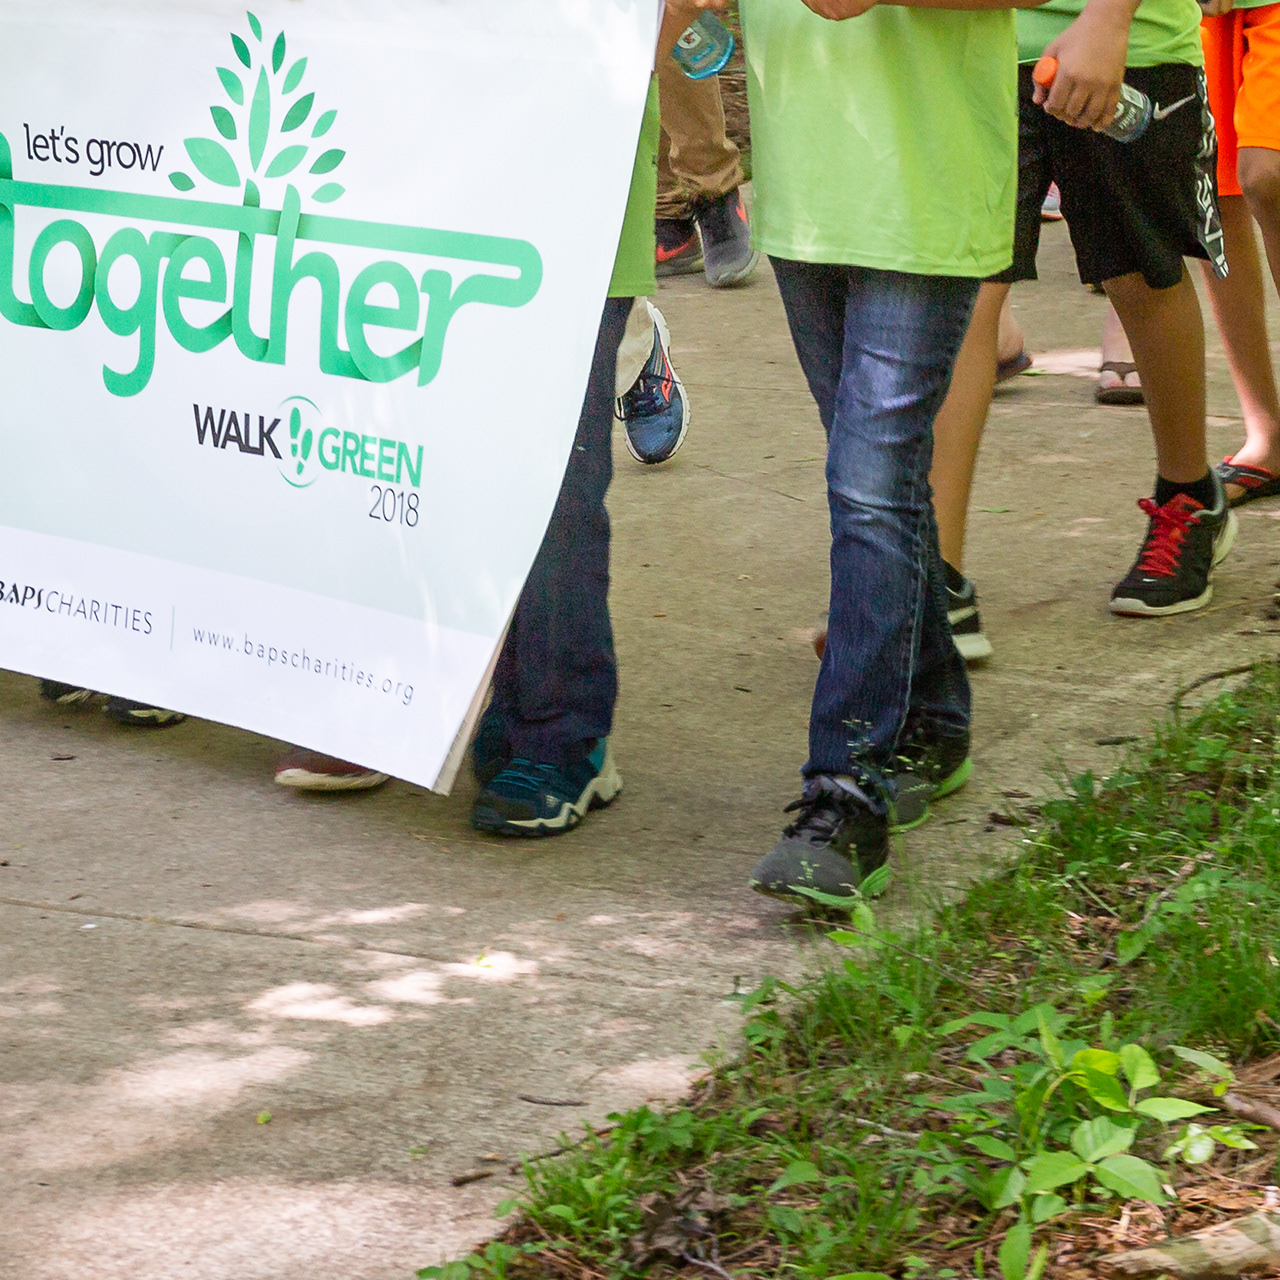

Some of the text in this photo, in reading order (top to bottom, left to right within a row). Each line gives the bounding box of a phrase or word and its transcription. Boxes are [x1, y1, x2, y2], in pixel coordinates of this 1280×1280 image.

[23, 122, 164, 176] let's grow
[192, 403, 424, 488] WALK GREEN
[369, 485, 420, 528] 2018
[193, 624, 415, 706] www.bapscharities.org
